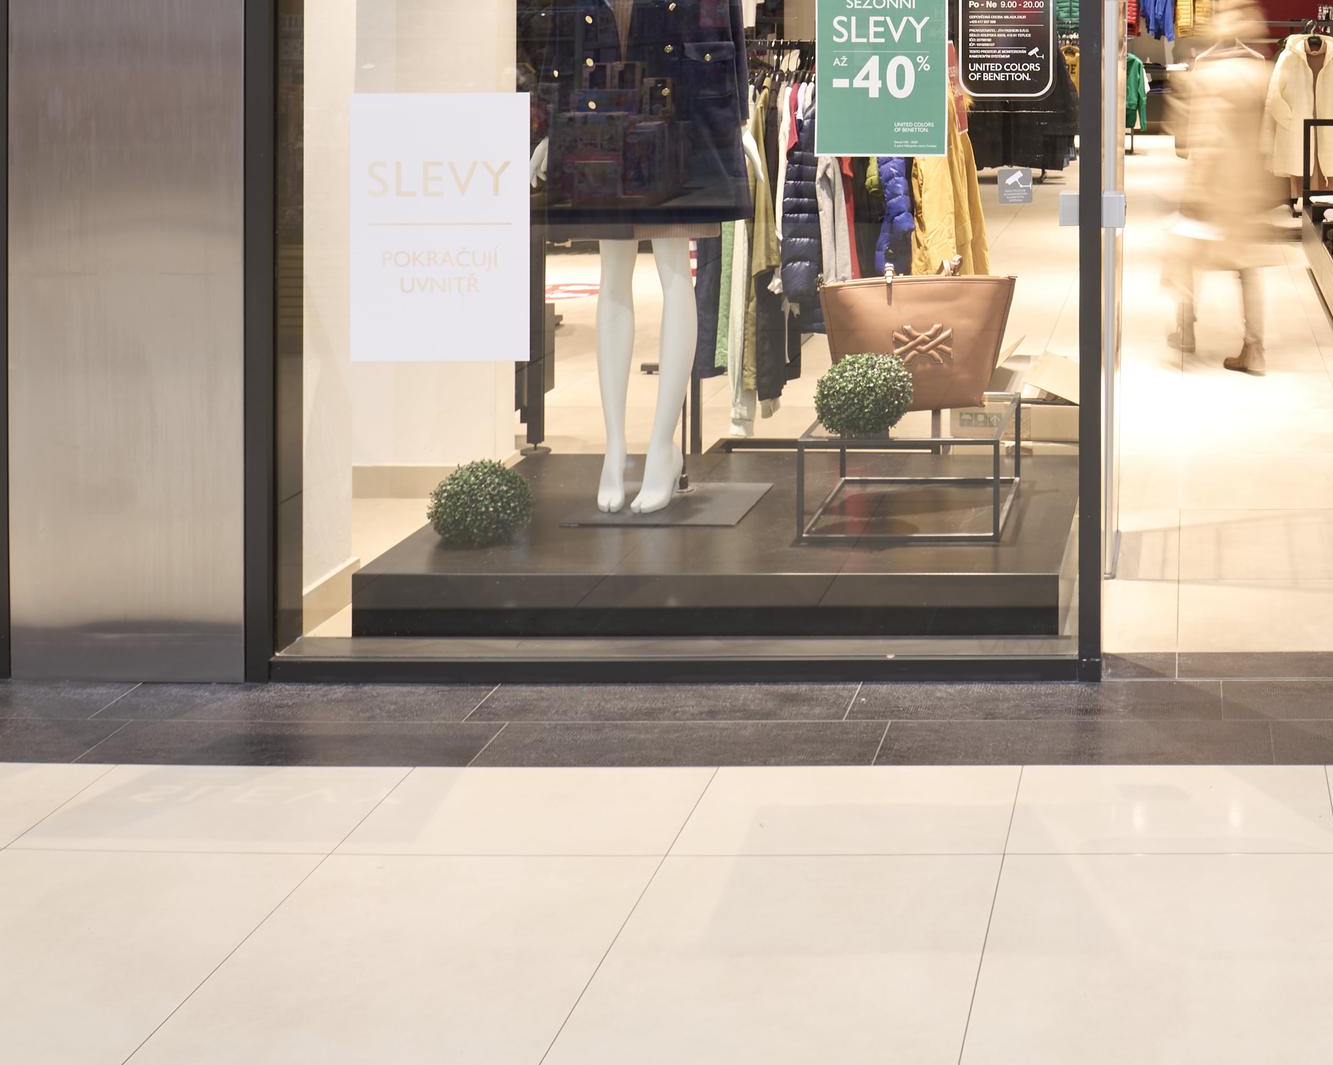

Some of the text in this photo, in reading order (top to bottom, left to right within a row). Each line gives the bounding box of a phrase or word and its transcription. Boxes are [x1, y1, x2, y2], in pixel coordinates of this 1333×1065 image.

[832, 15, 930, 43] SLEVY
[833, 56, 848, 67] AŽ
[968, 63, 1041, 71] UNITED COLORS
[968, 73, 1031, 81] OF BENETTON.
[367, 160, 512, 198] SLEVY
[381, 245, 499, 272] POKRAČUJÍ
[399, 273, 480, 294] UVNITŘ
